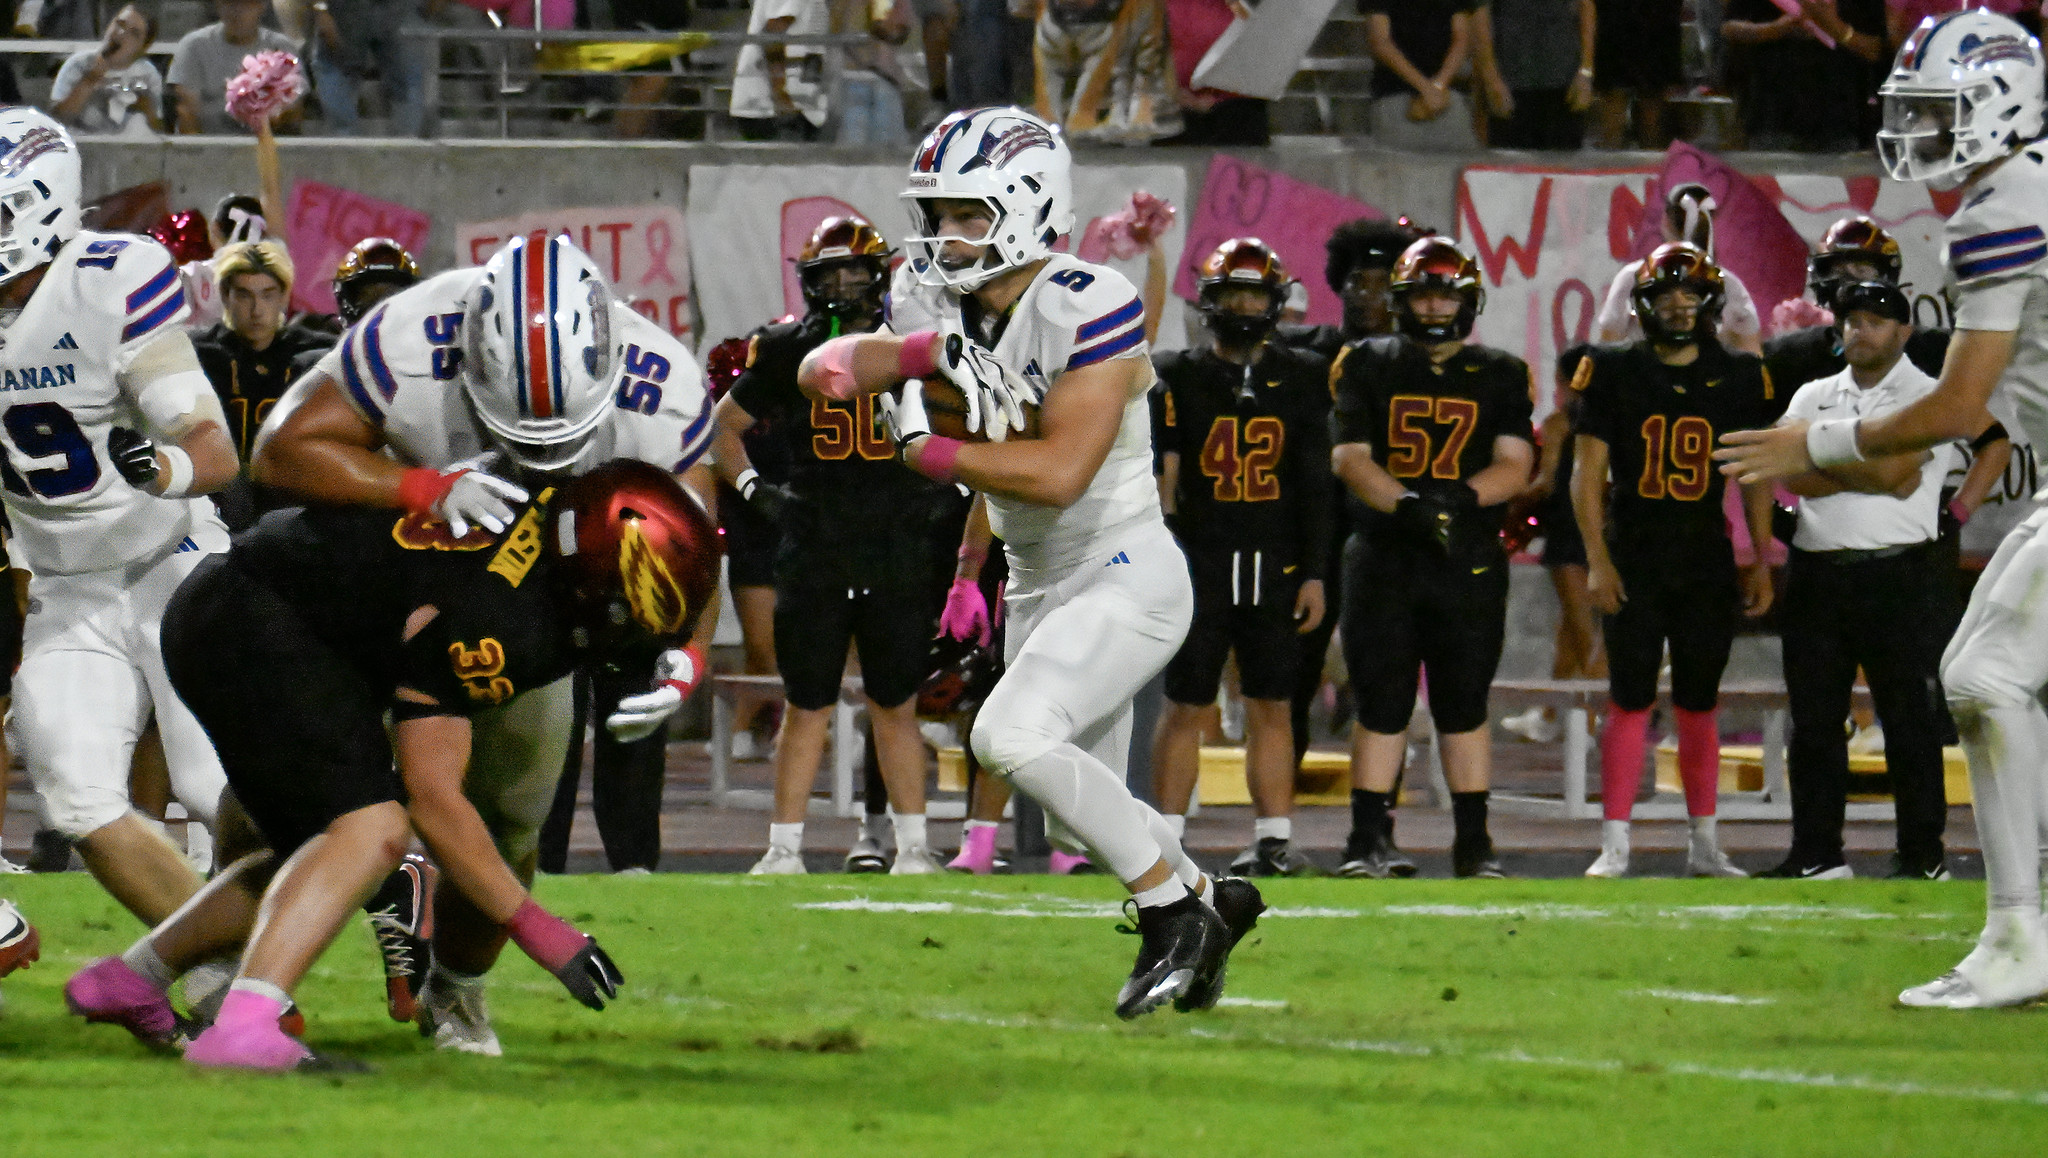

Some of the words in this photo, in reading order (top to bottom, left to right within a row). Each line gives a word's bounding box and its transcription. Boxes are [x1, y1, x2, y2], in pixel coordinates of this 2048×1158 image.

[1048, 268, 1096, 293] 5
[0, 363, 76, 392] ANAN
[616, 343, 671, 416] 55
[1200, 416, 1285, 502] 42
[1388, 395, 1478, 480] 57
[1638, 414, 1713, 501] 19
